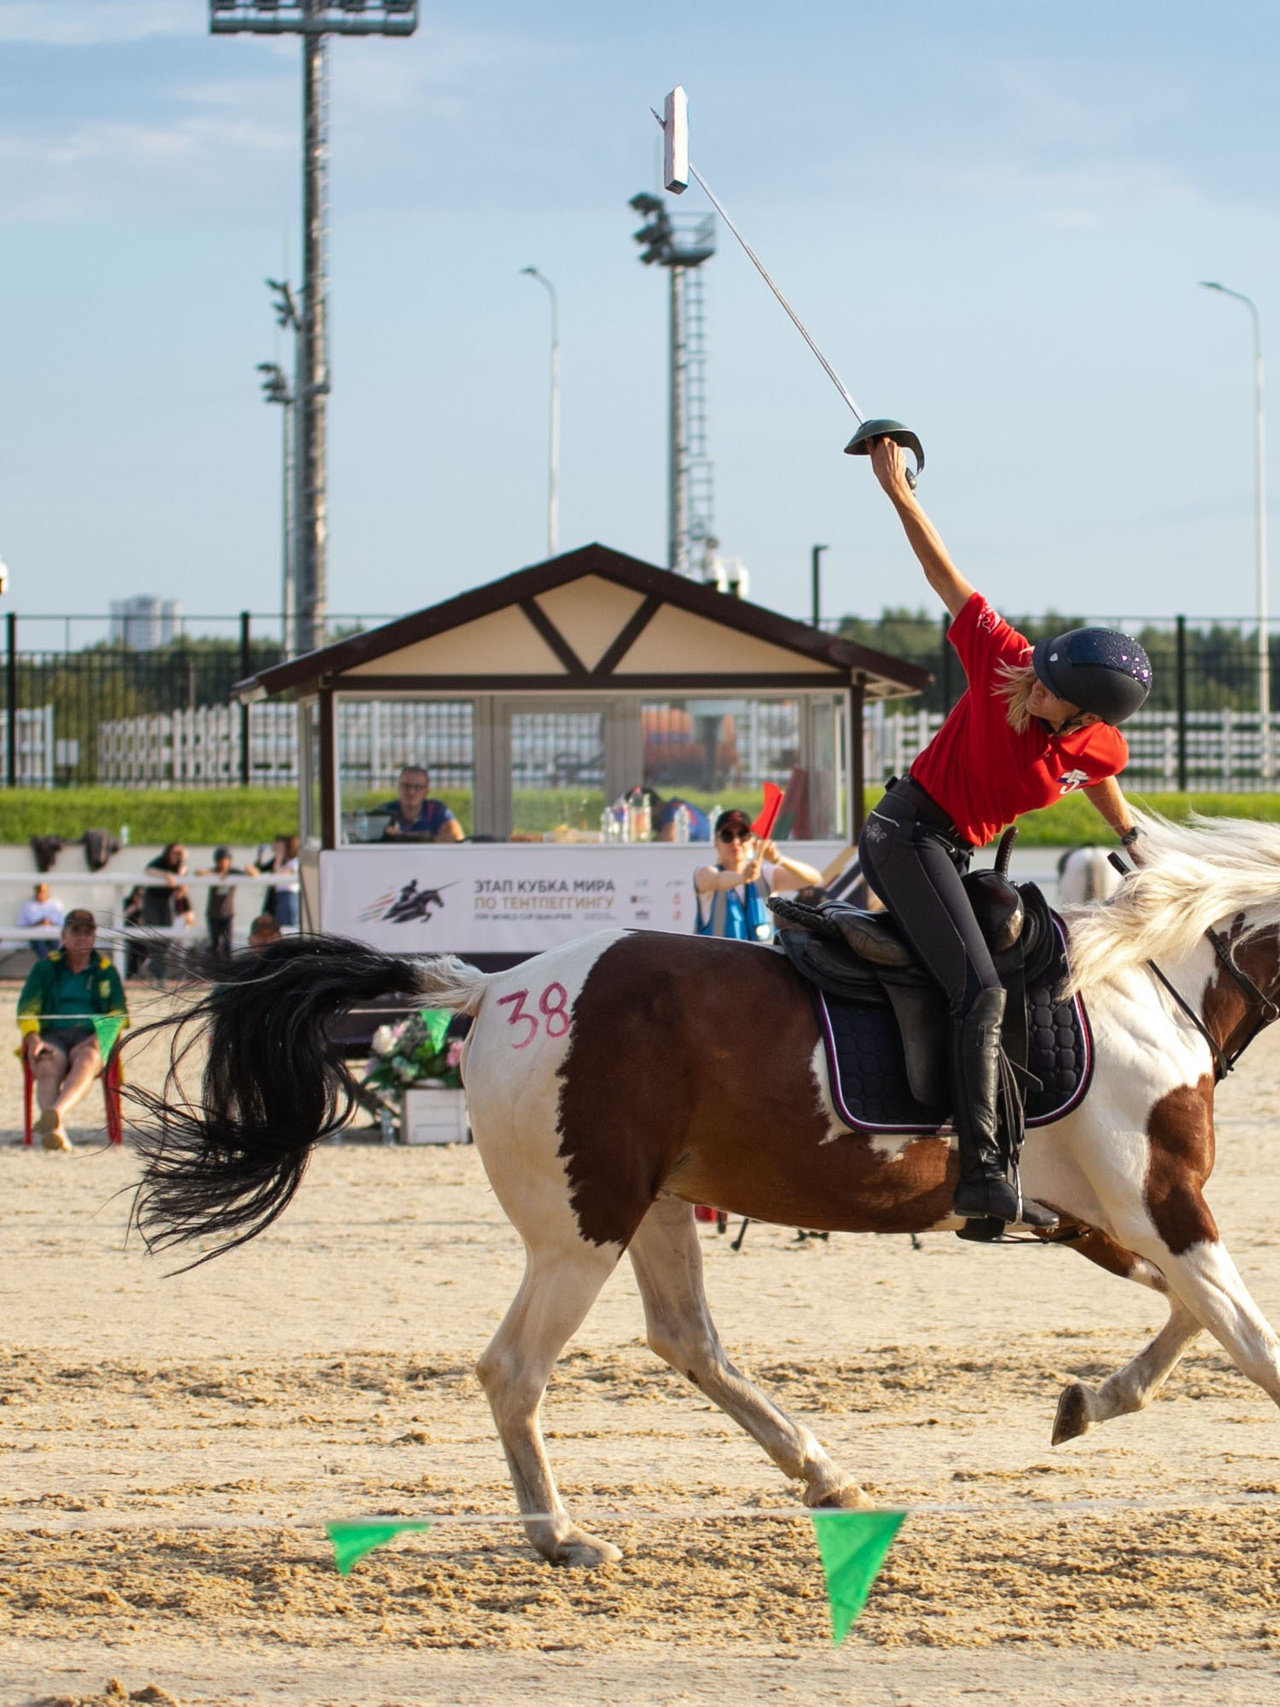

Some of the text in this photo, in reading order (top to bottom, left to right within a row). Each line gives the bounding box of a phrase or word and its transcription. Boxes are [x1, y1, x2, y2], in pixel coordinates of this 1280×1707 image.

[474, 880, 616, 894] ЭТАП КУБКА МИРА
[474, 896, 615, 910] ПО ТЕНТПЕГГИНГУ
[496, 982, 571, 1050] 38
